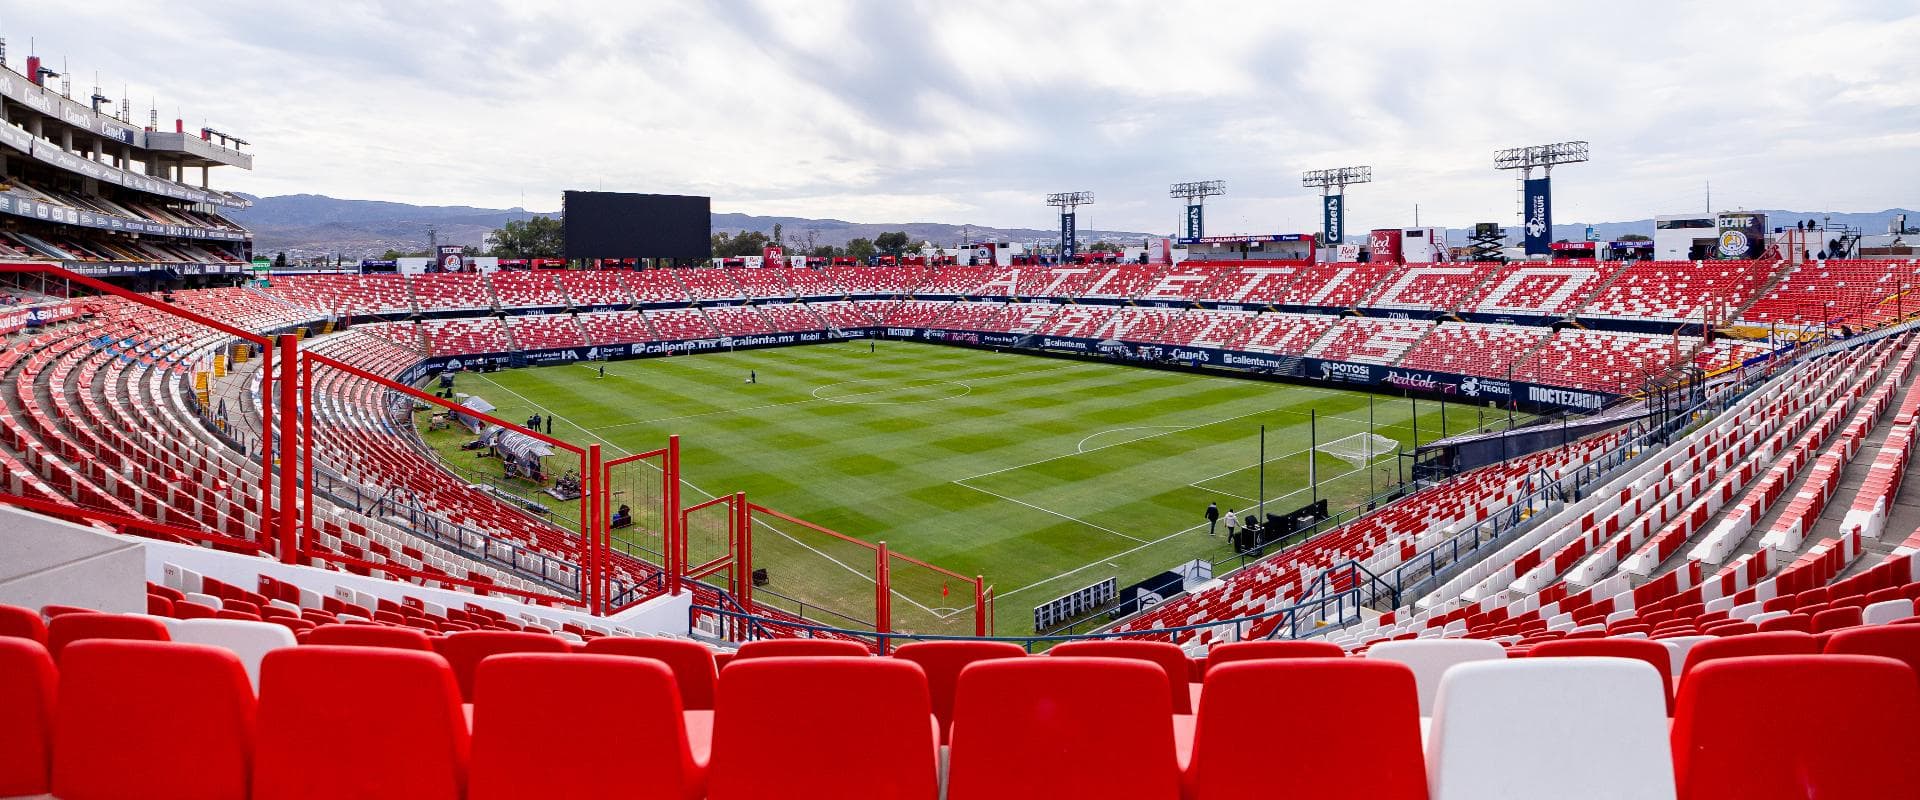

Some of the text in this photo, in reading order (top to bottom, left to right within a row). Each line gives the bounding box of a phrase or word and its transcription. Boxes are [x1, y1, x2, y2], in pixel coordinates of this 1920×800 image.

[101, 121, 126, 141] Canel's
[1190, 207, 1199, 238] anel's
[1328, 198, 1338, 242] Canel's
[1371, 236, 1390, 248] Red
[1387, 311, 1410, 320] ZONA
[732, 334, 795, 347] caliente.mx
[801, 332, 820, 341] Mobil
[646, 340, 716, 354] caliente.mx
[1050, 339, 1086, 350] caliente.mx
[1172, 348, 1210, 361] Canel's
[1232, 355, 1280, 368] caliente.mx
[1383, 370, 1411, 385] Red
[1529, 386, 1602, 409] MOCTEZUMA
